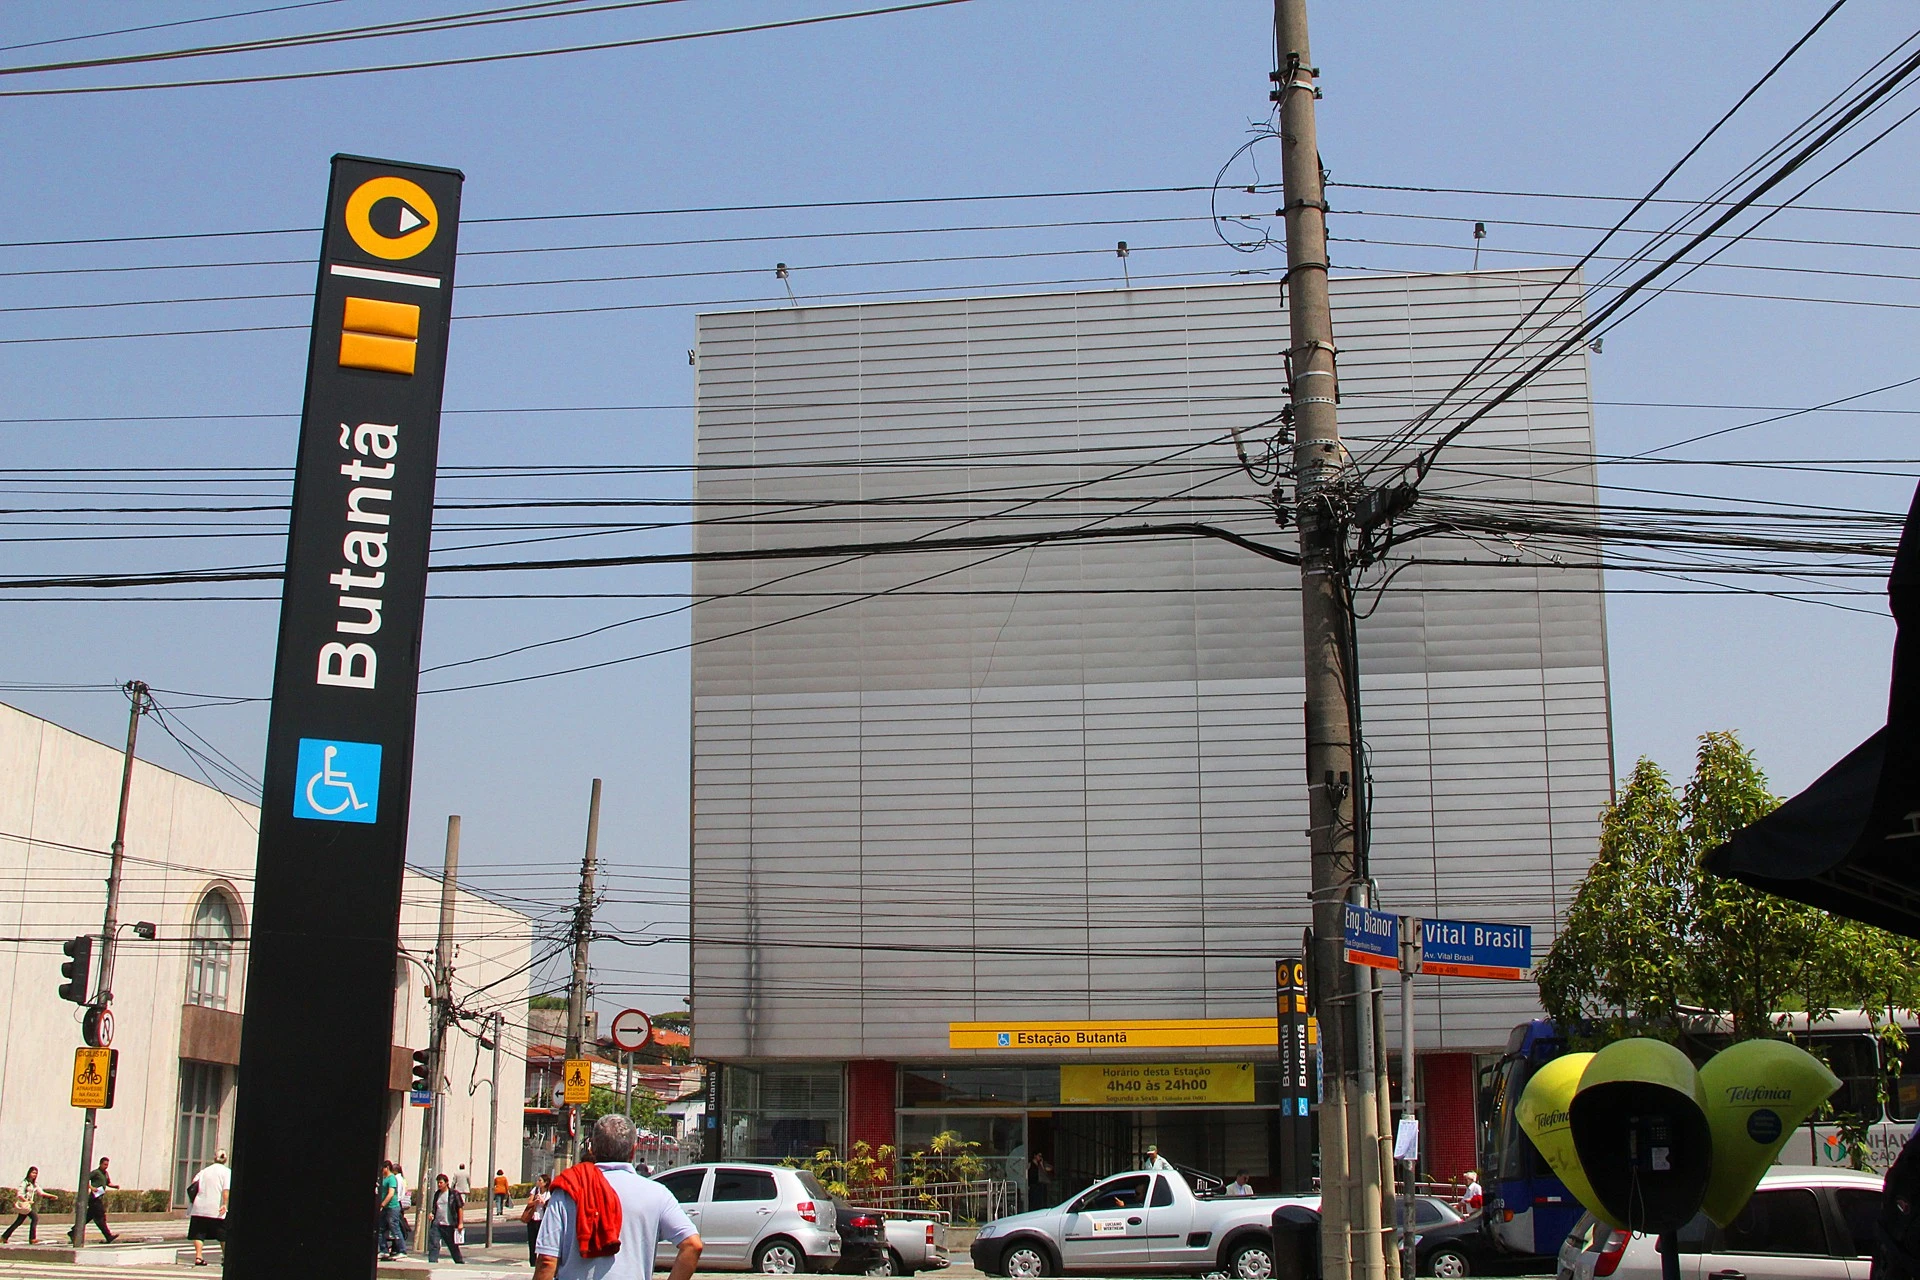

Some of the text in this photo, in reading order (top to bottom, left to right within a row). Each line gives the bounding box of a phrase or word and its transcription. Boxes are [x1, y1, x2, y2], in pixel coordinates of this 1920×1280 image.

[316, 422, 399, 690] Butantã
[1345, 907, 1392, 937] Eng. Bianor
[1425, 923, 1524, 949] Vital Brasil
[1424, 951, 1474, 962] Av. Vital Brasil
[1017, 1031, 1127, 1046] Estação Butantã
[1282, 1024, 1290, 1087] Butantã
[1297, 1024, 1307, 1087] Butantã
[1103, 1066, 1211, 1077] Horário desta Estação
[1107, 1079, 1208, 1091] 4h40 às 24h00
